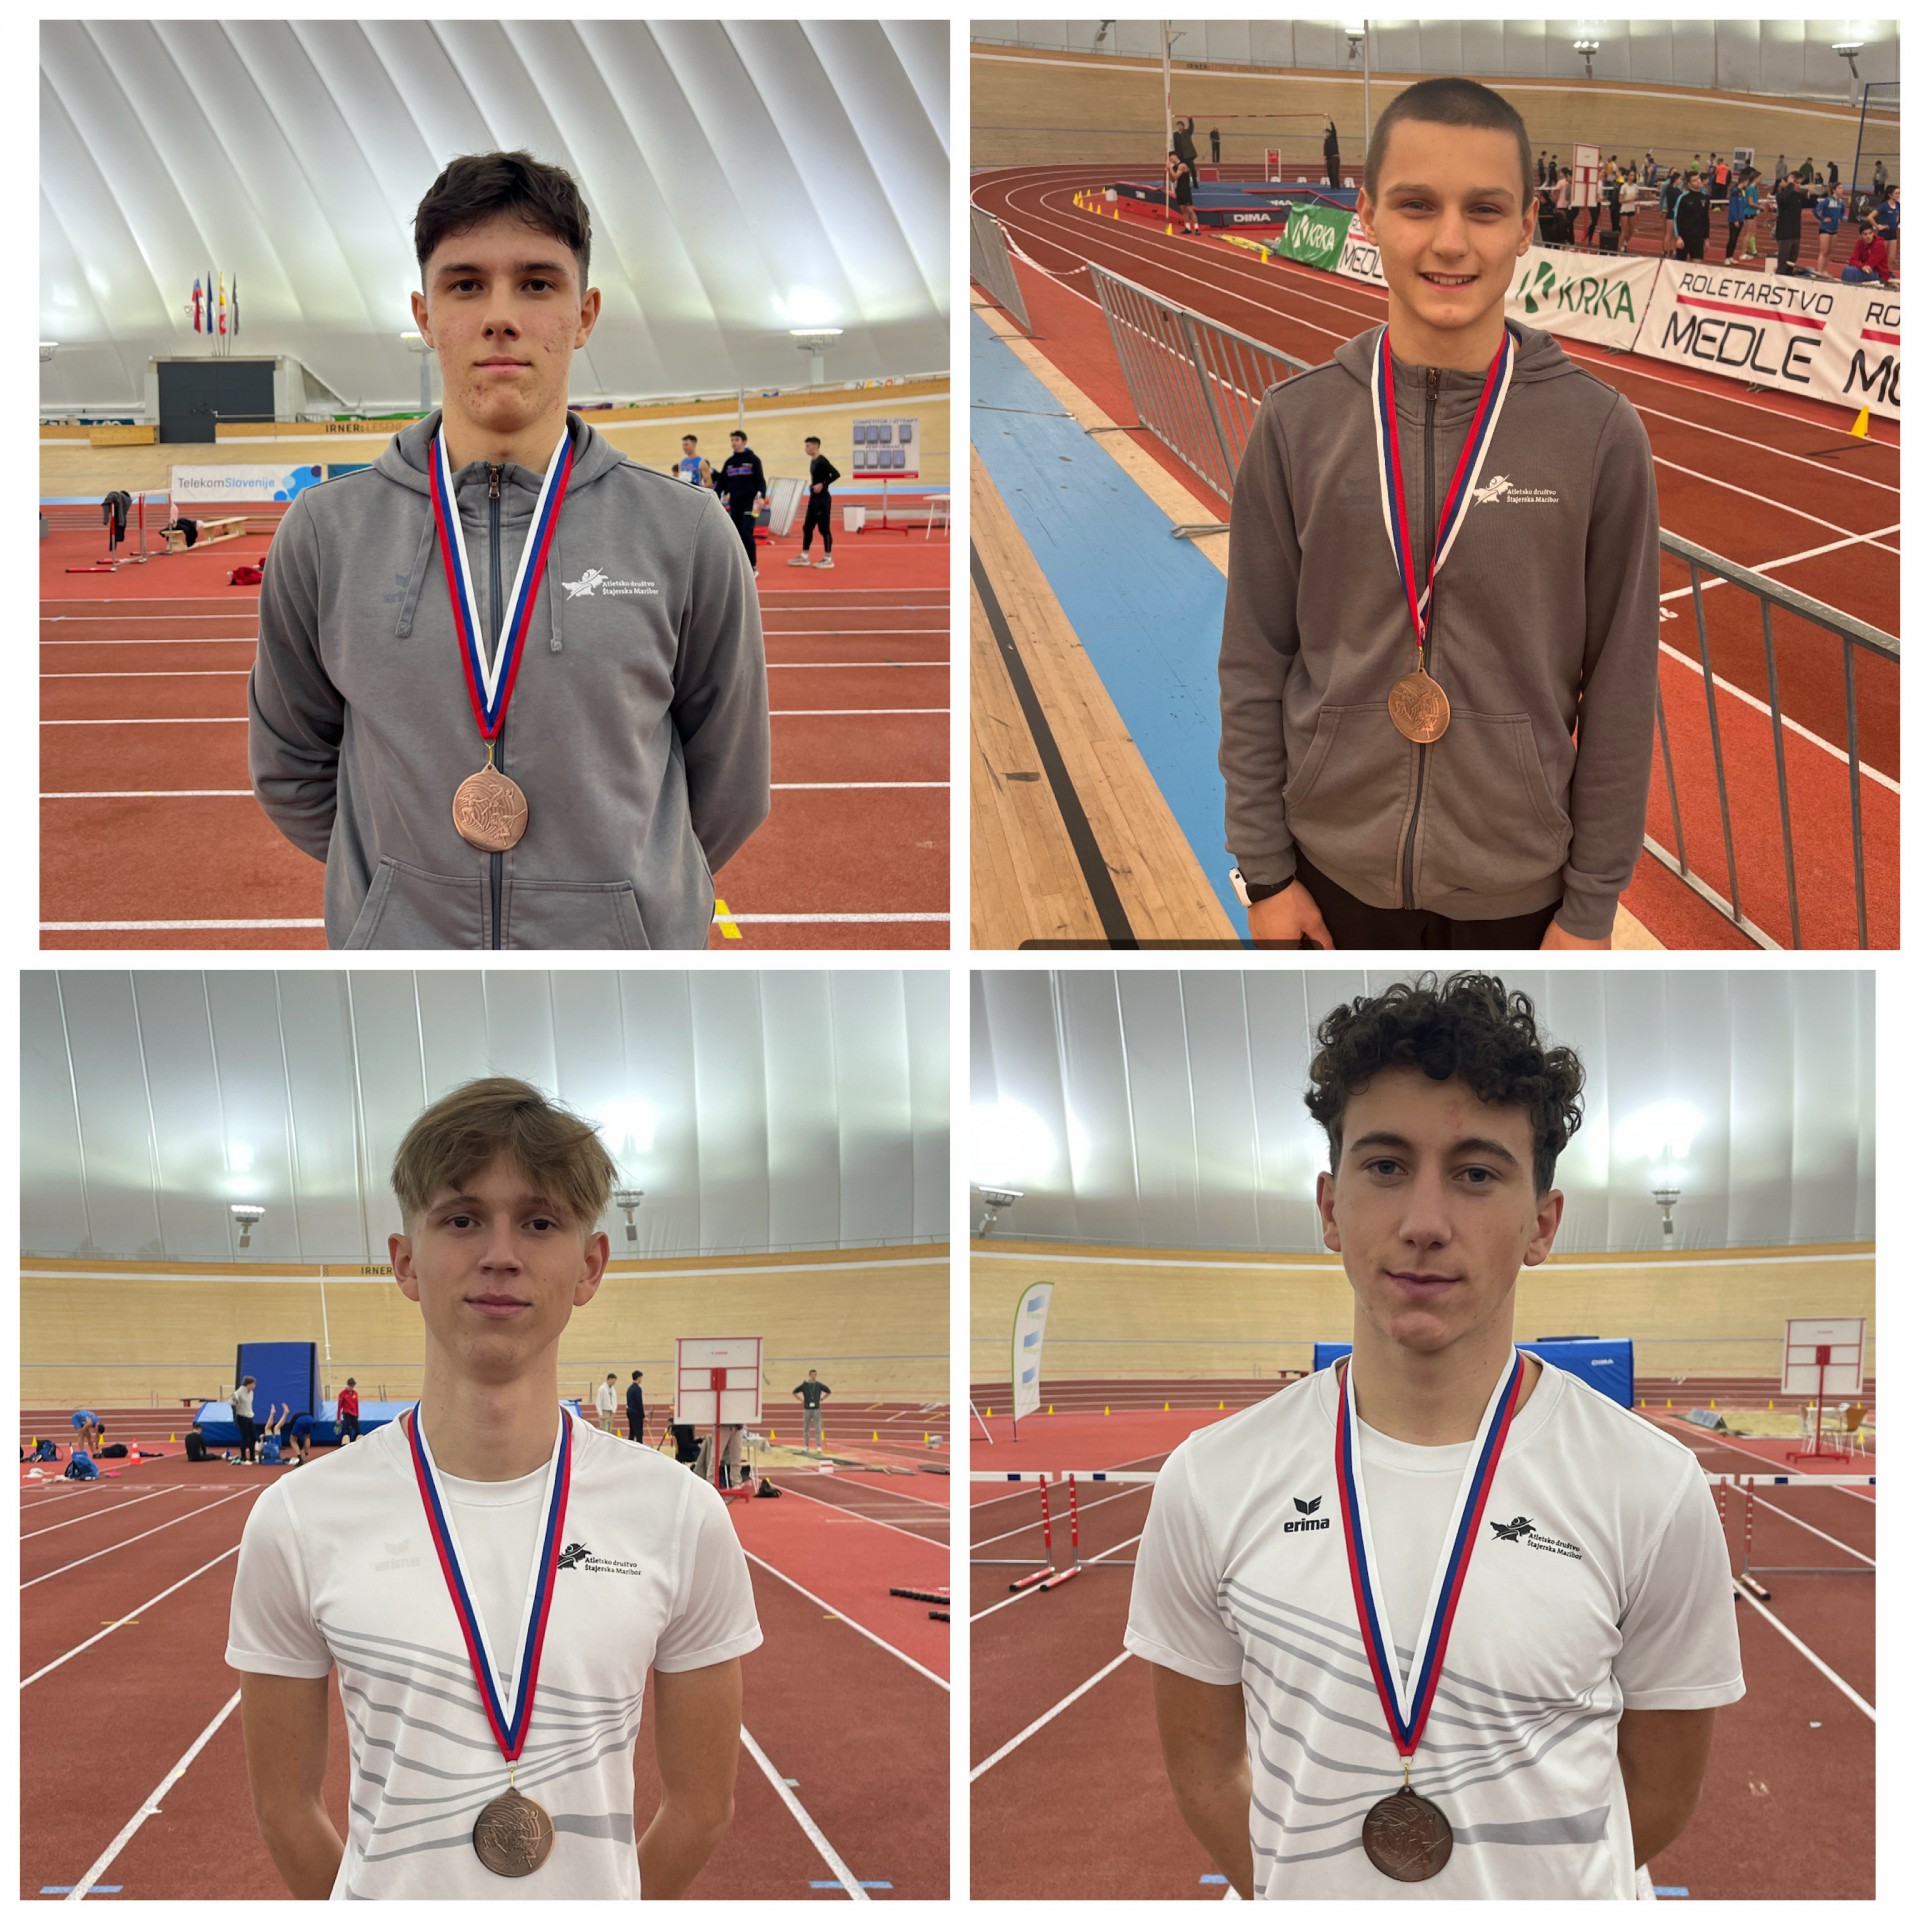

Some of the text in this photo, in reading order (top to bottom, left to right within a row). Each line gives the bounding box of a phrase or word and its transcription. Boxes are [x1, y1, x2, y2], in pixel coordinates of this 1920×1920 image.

[1233, 213, 1271, 223] DIMA
[1306, 223, 1336, 252] KRKA
[1557, 275, 1635, 324] KRKA
[1679, 272, 1834, 315] ROLETARSTVO
[1661, 310, 1822, 384] MEDLE
[1506, 496, 1535, 504] Štajerska
[602, 580, 631, 588] Atletsko
[602, 588, 633, 596] Štajerska
[1284, 1518, 1330, 1533] erima
[1527, 1540, 1582, 1560] Štajerska Maribor
[1528, 1533, 1580, 1552] Atletsko društvo
[585, 1557, 638, 1568] Atletsko društvo
[585, 1564, 641, 1576] Štajerska Maribor
